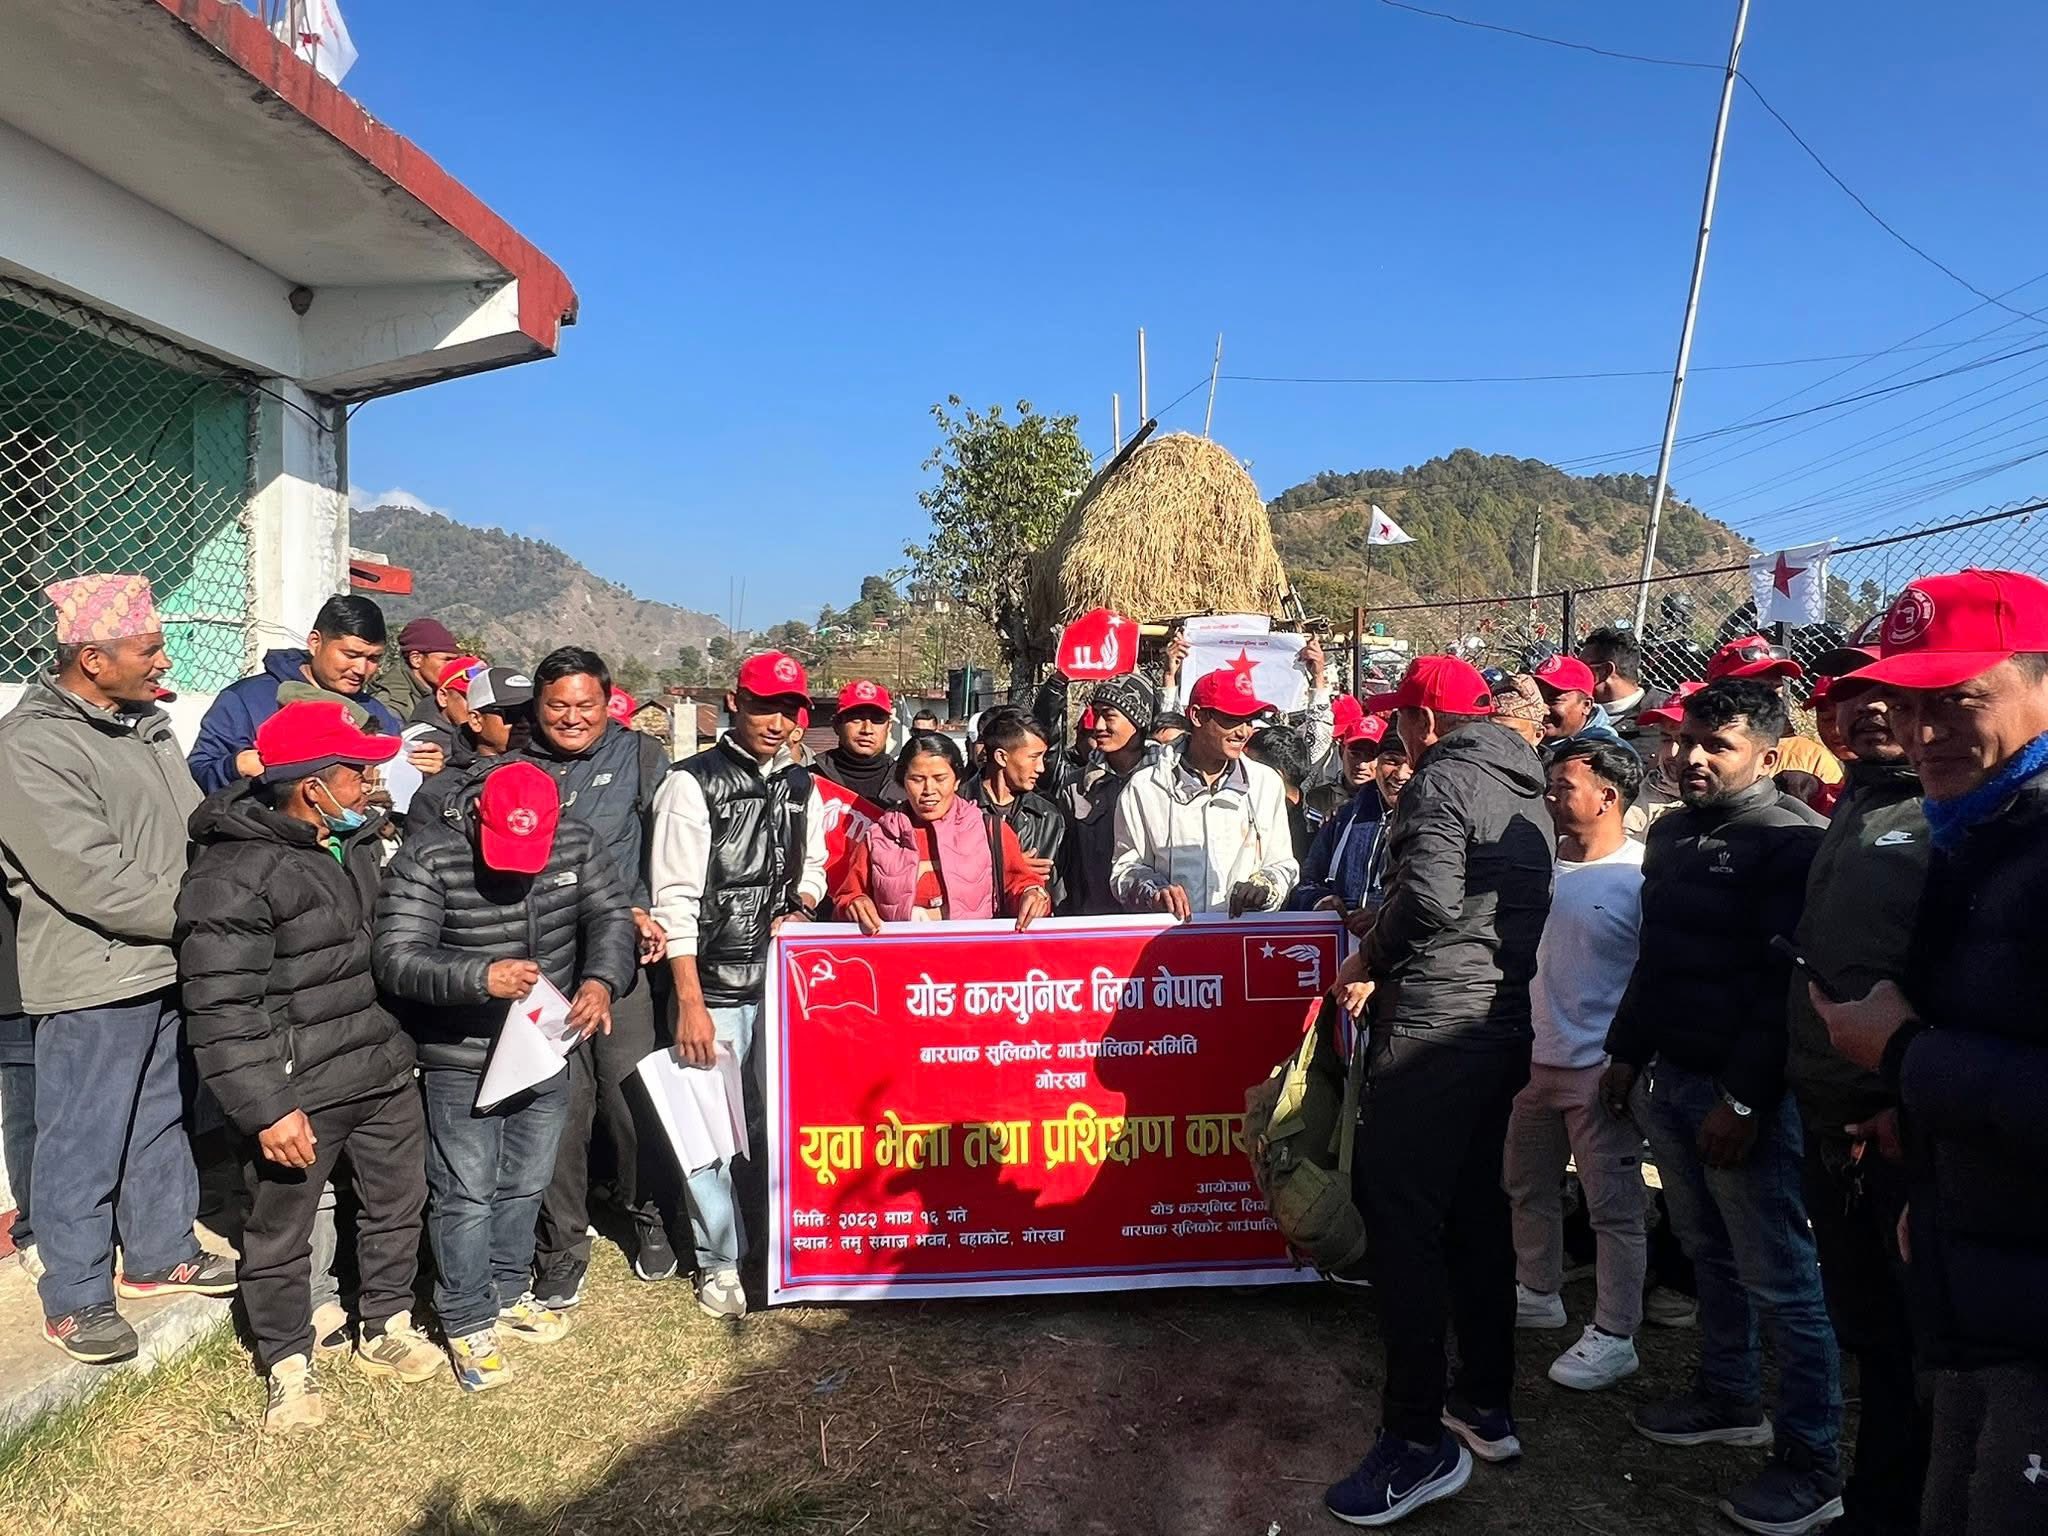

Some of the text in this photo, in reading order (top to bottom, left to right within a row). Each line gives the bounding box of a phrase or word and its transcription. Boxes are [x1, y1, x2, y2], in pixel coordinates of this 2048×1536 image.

[905, 965, 1224, 1025] योङ कम्युनिष्ट लिग नेपाल
[919, 1046, 981, 1064] बारपाक
[984, 1039, 1053, 1067] सुलिकोट
[1148, 1033, 1199, 1056] समिति
[1035, 1069, 1087, 1091] गोरखा
[874, 1109, 951, 1170] भेला
[963, 1120, 1031, 1169] तथा
[1042, 1101, 1175, 1171] प्रशिक्षण
[1196, 1180, 1251, 1194] आयोजक
[838, 1212, 878, 1230] २०८२
[884, 1210, 914, 1226] माघ
[919, 1210, 940, 1226] १६
[946, 1206, 968, 1223] गते
[868, 1234, 910, 1250] समाज
[914, 1233, 952, 1249] भवन,
[1022, 1227, 1066, 1245] गोरखा
